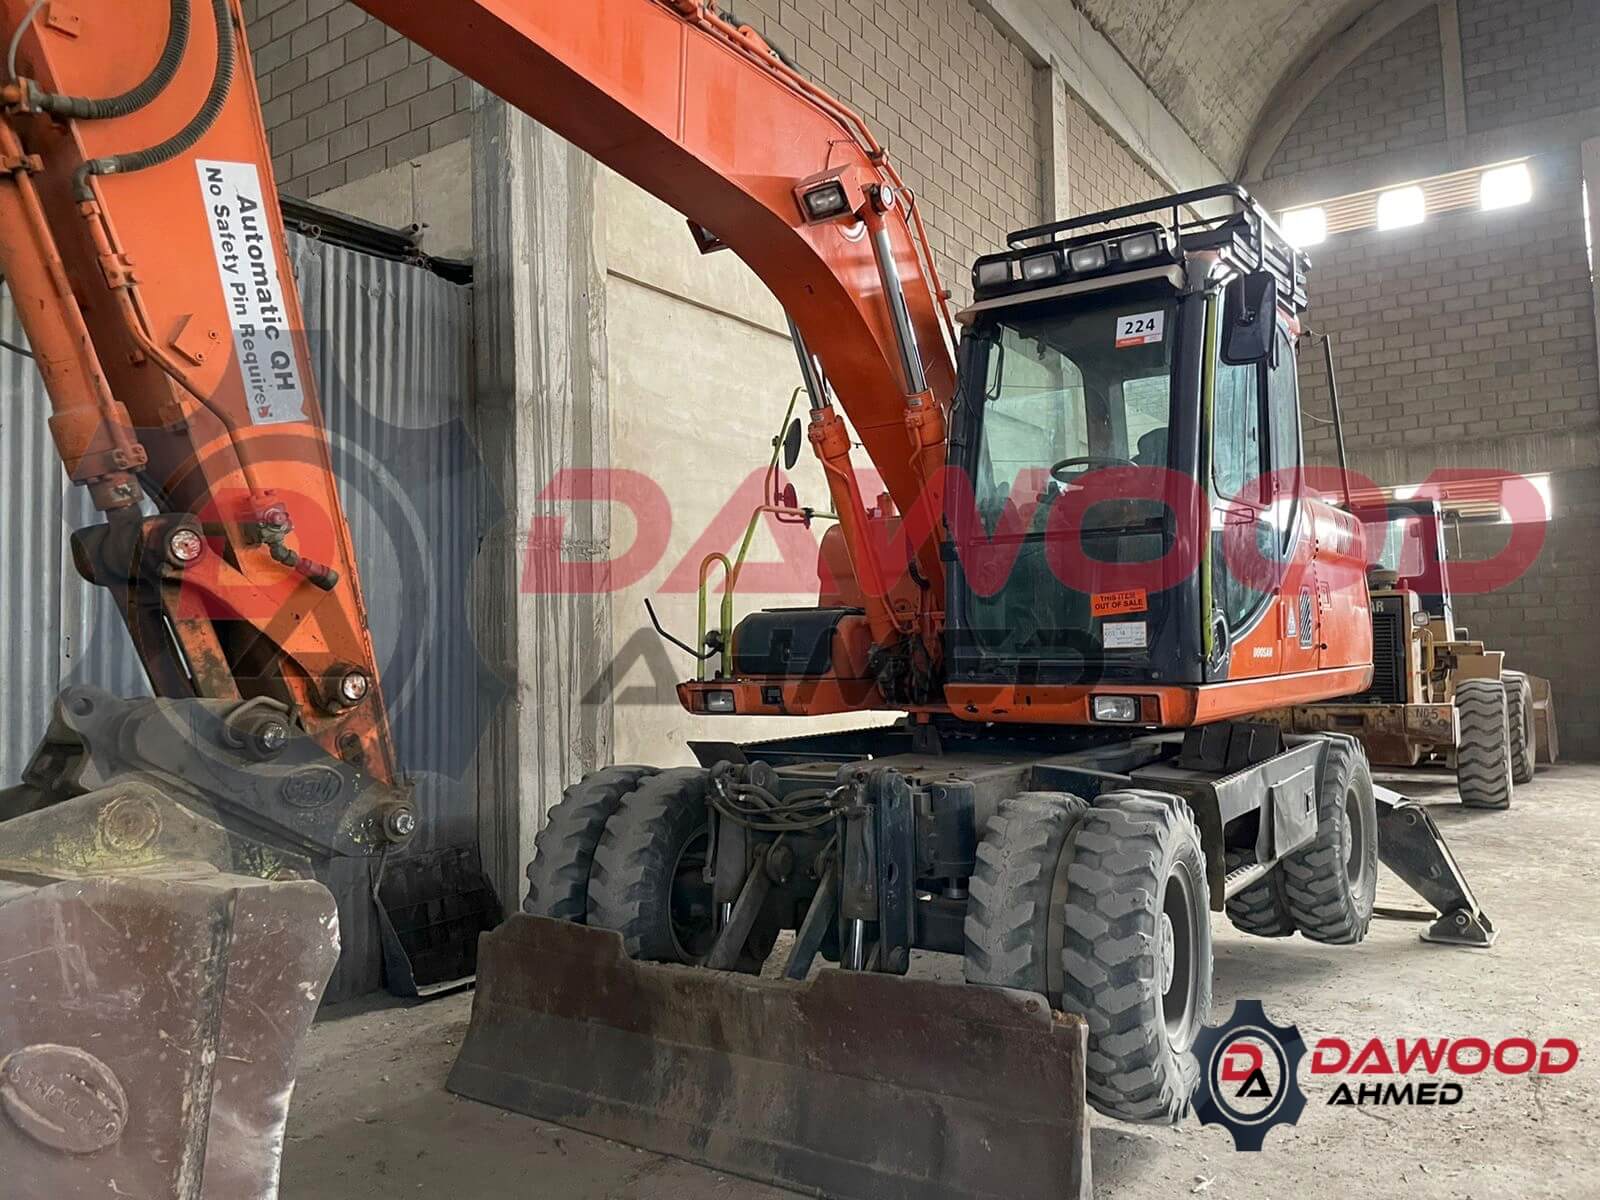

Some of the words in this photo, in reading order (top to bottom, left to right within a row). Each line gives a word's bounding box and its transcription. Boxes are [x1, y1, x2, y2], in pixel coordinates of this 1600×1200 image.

[205, 167, 224, 196] No
[213, 204, 239, 274] Safety
[230, 282, 249, 316] Pin
[236, 194, 282, 341] Automatic
[270, 350, 297, 391] QH
[1124, 317, 1155, 335] 224
[1111, 601, 1122, 609] OF
[1123, 598, 1144, 607] SALE
